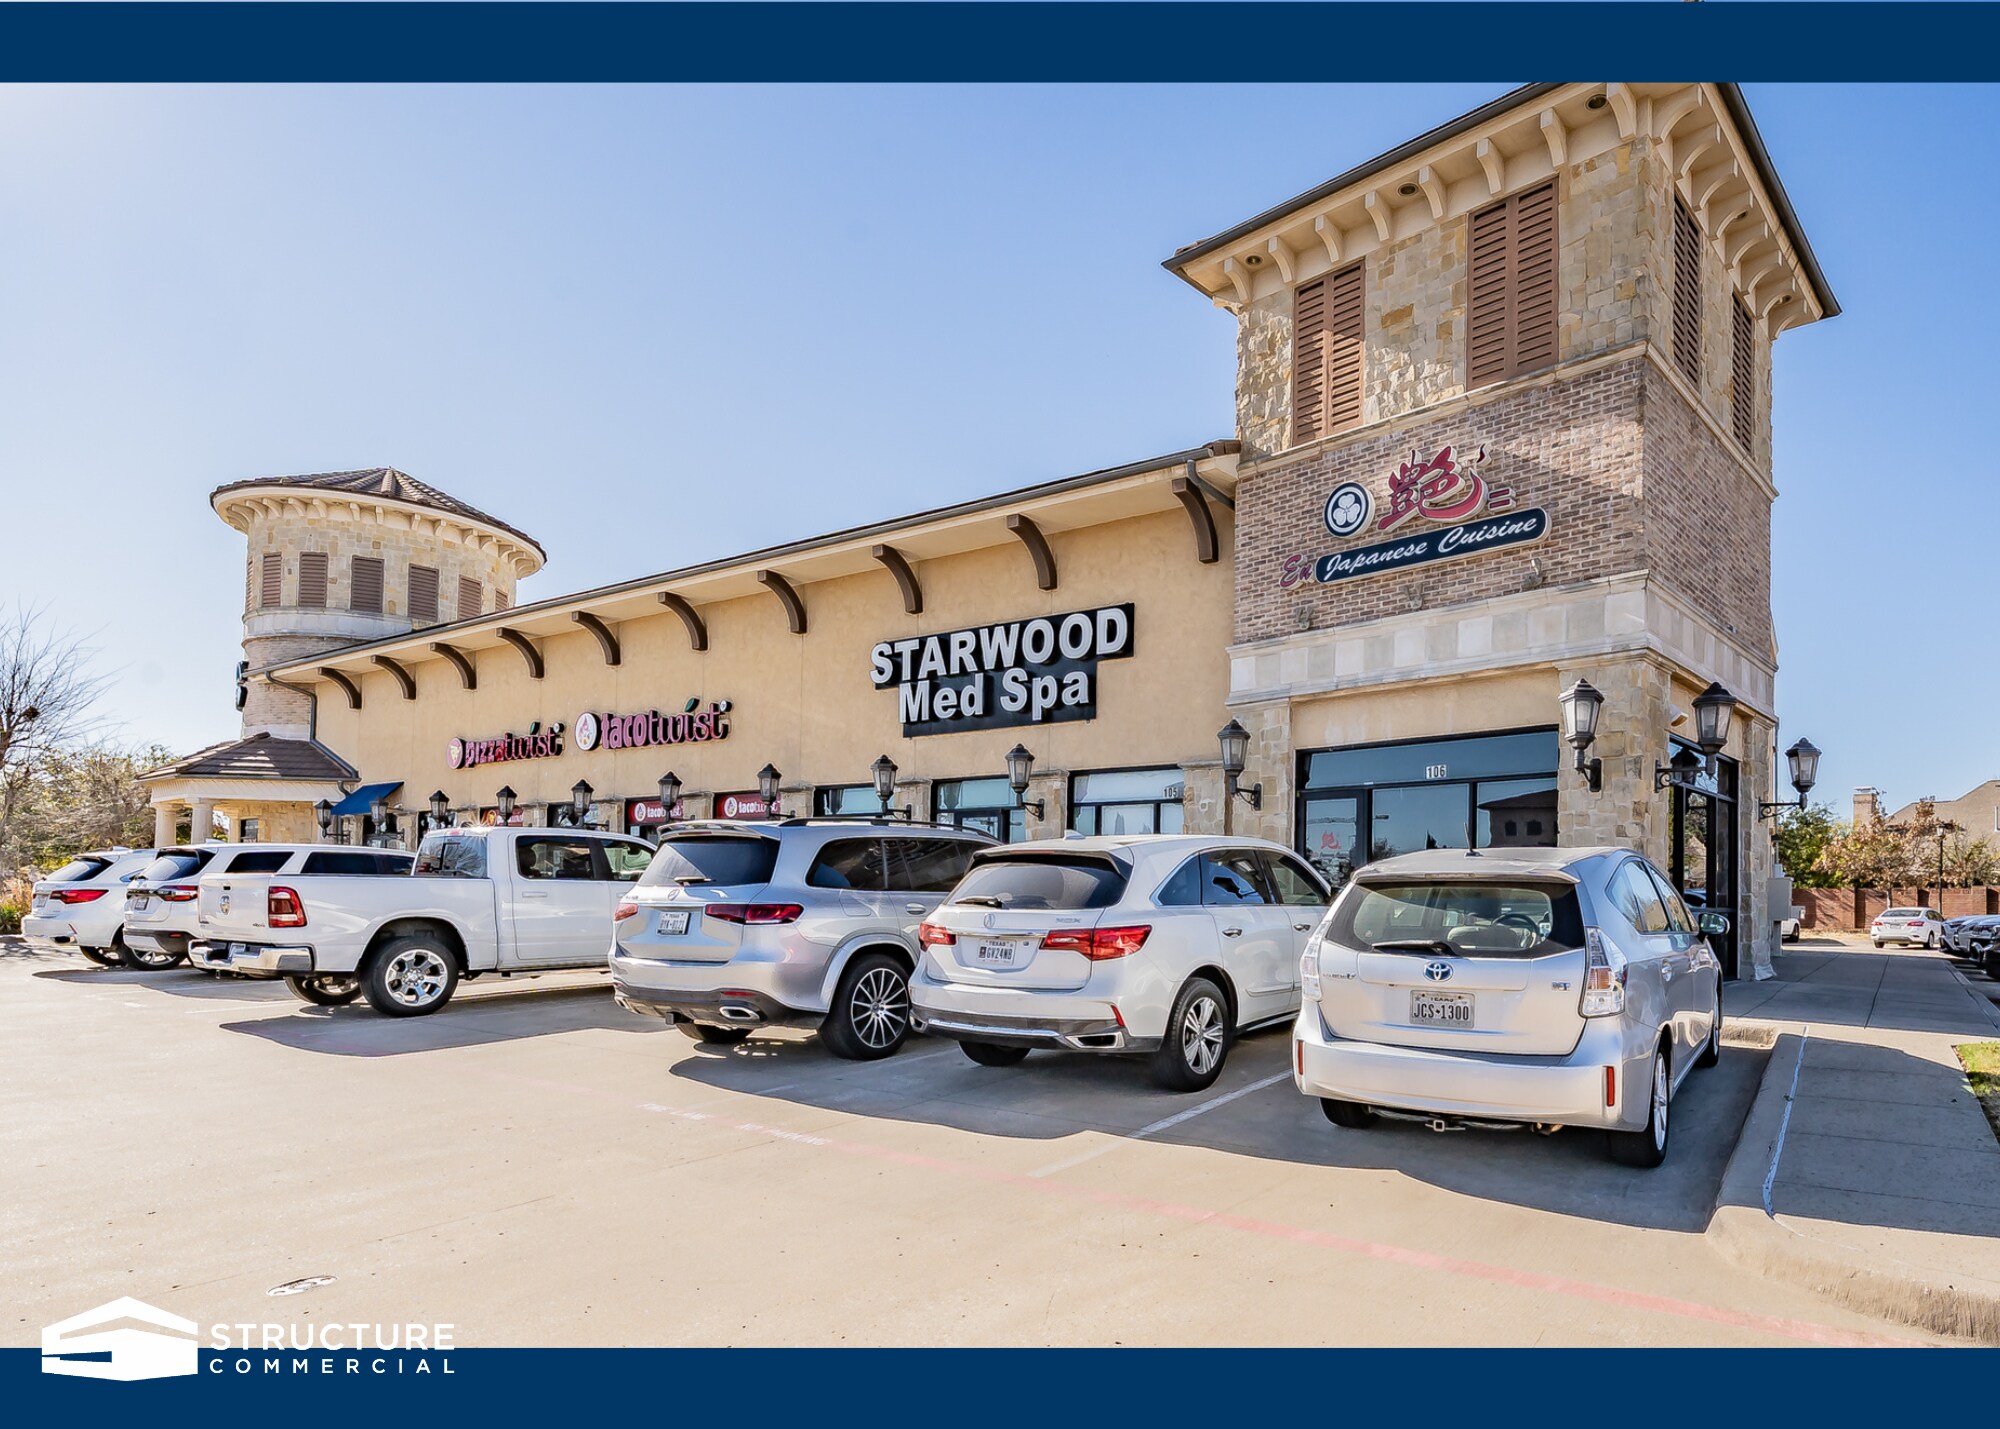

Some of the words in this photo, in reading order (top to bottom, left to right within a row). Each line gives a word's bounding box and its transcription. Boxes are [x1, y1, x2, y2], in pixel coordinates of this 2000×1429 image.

[1279, 554, 1313, 588] En
[1323, 541, 1428, 582] Japanese
[1437, 517, 1538, 553] Cuisine
[869, 607, 1129, 684] STARWOOD
[900, 672, 984, 723] Med
[1000, 667, 1090, 721] Spa
[1163, 787, 1178, 799] 105
[1426, 765, 1446, 779] 106
